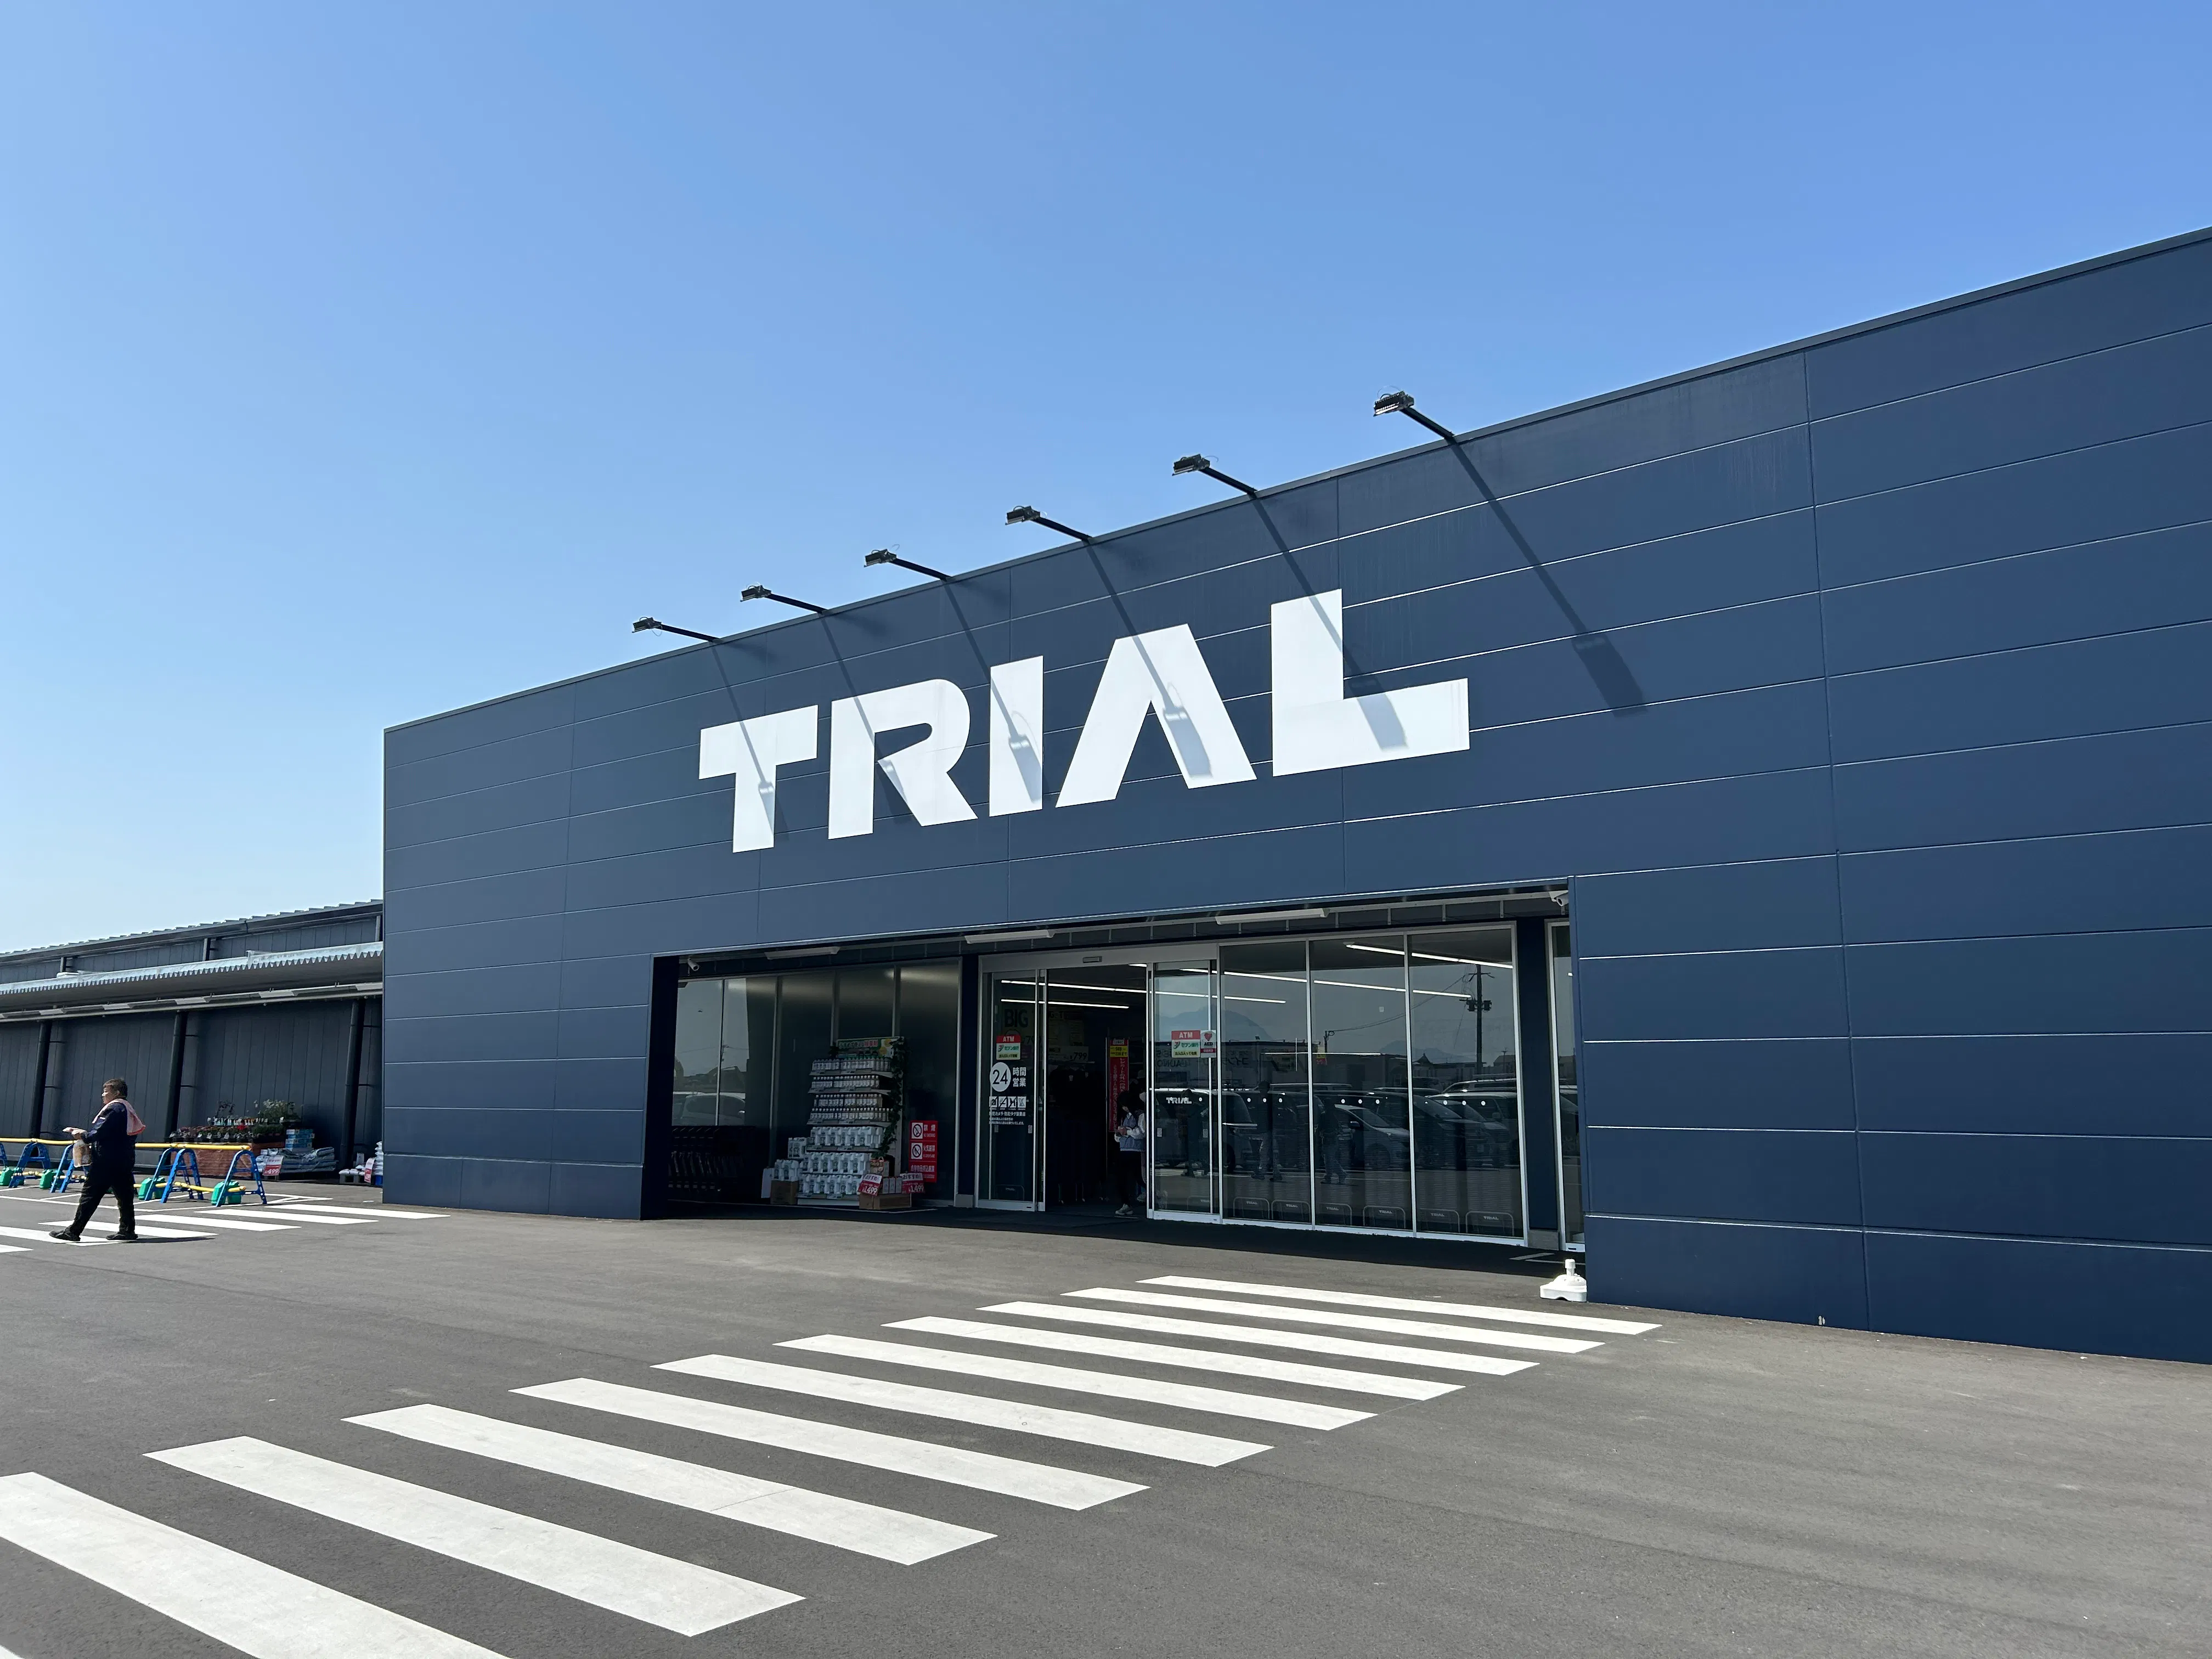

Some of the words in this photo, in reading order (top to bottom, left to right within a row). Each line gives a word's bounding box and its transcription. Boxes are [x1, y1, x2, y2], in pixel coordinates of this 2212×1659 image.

[699, 589, 1470, 853] TRIAL
[1005, 1009, 1028, 1028] BIG
[992, 1069, 1008, 1085] 24
[1013, 1067, 1026, 1076] 時間
[1013, 1077, 1026, 1087] 営業
